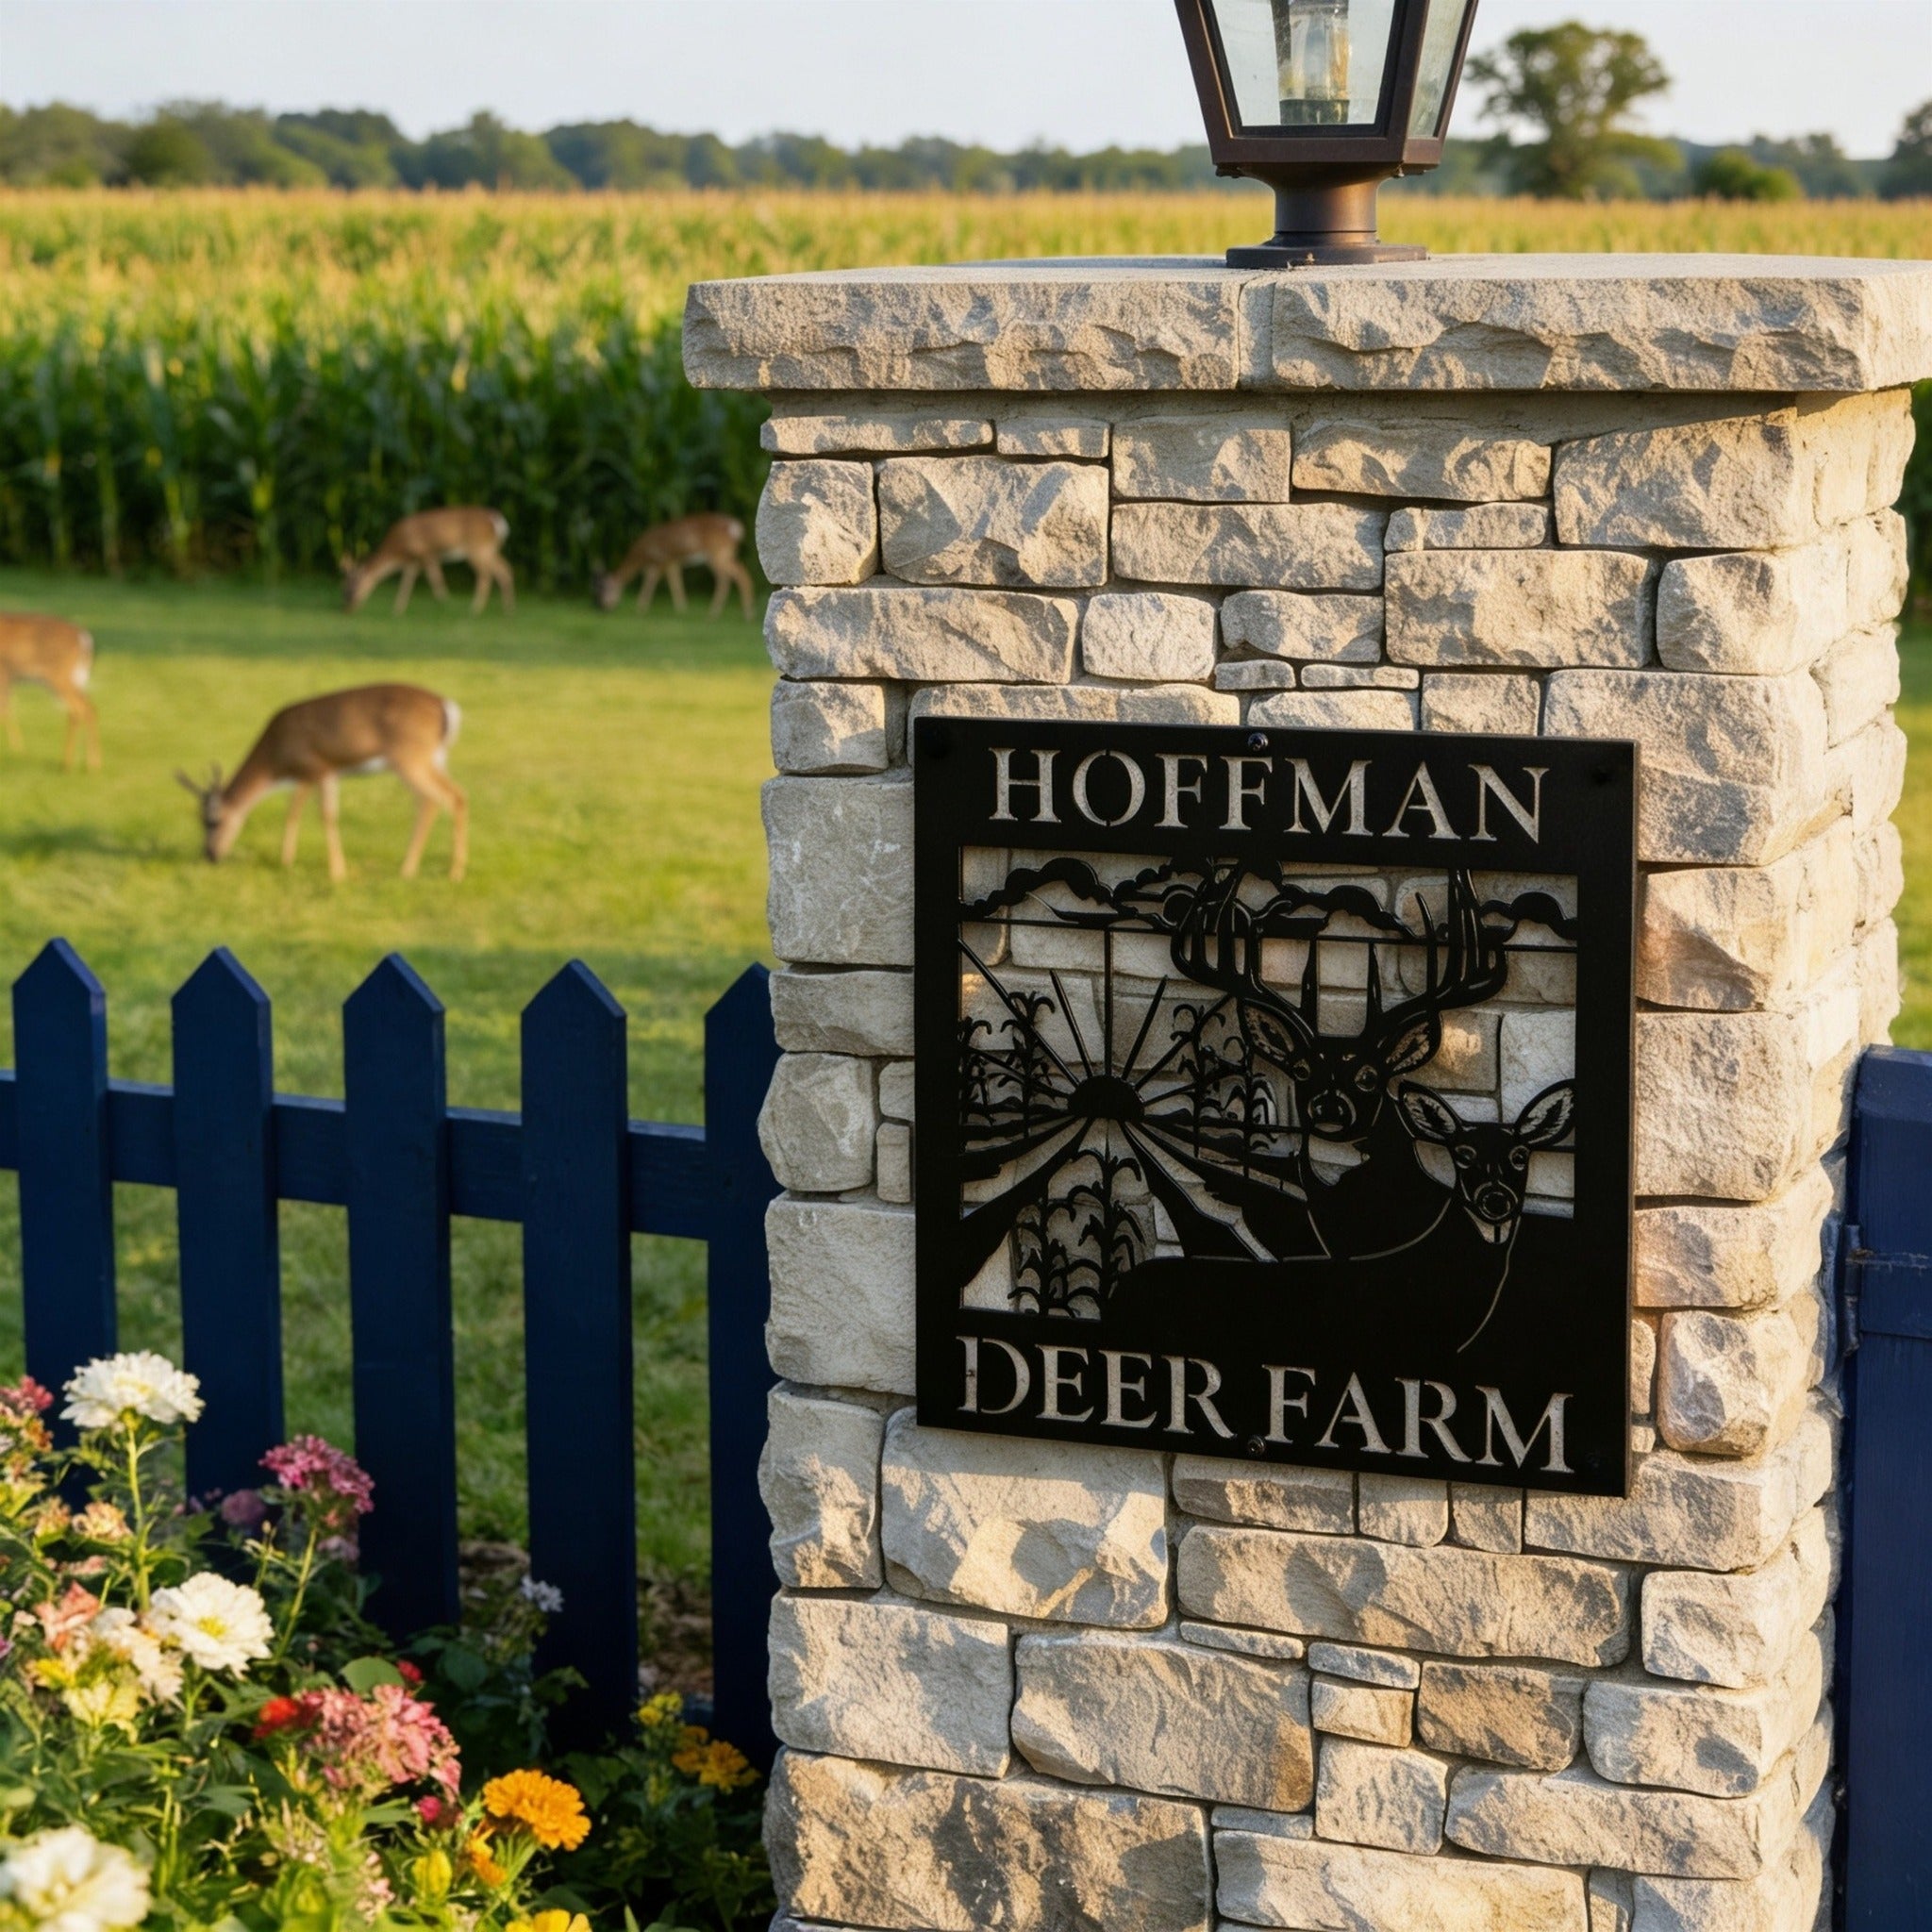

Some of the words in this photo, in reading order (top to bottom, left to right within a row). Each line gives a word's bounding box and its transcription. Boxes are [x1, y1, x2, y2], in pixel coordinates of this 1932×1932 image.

[990, 748, 1548, 844] HOFFMAN
[958, 1336, 1235, 1439] DEER
[1263, 1365, 1574, 1474] FARM
